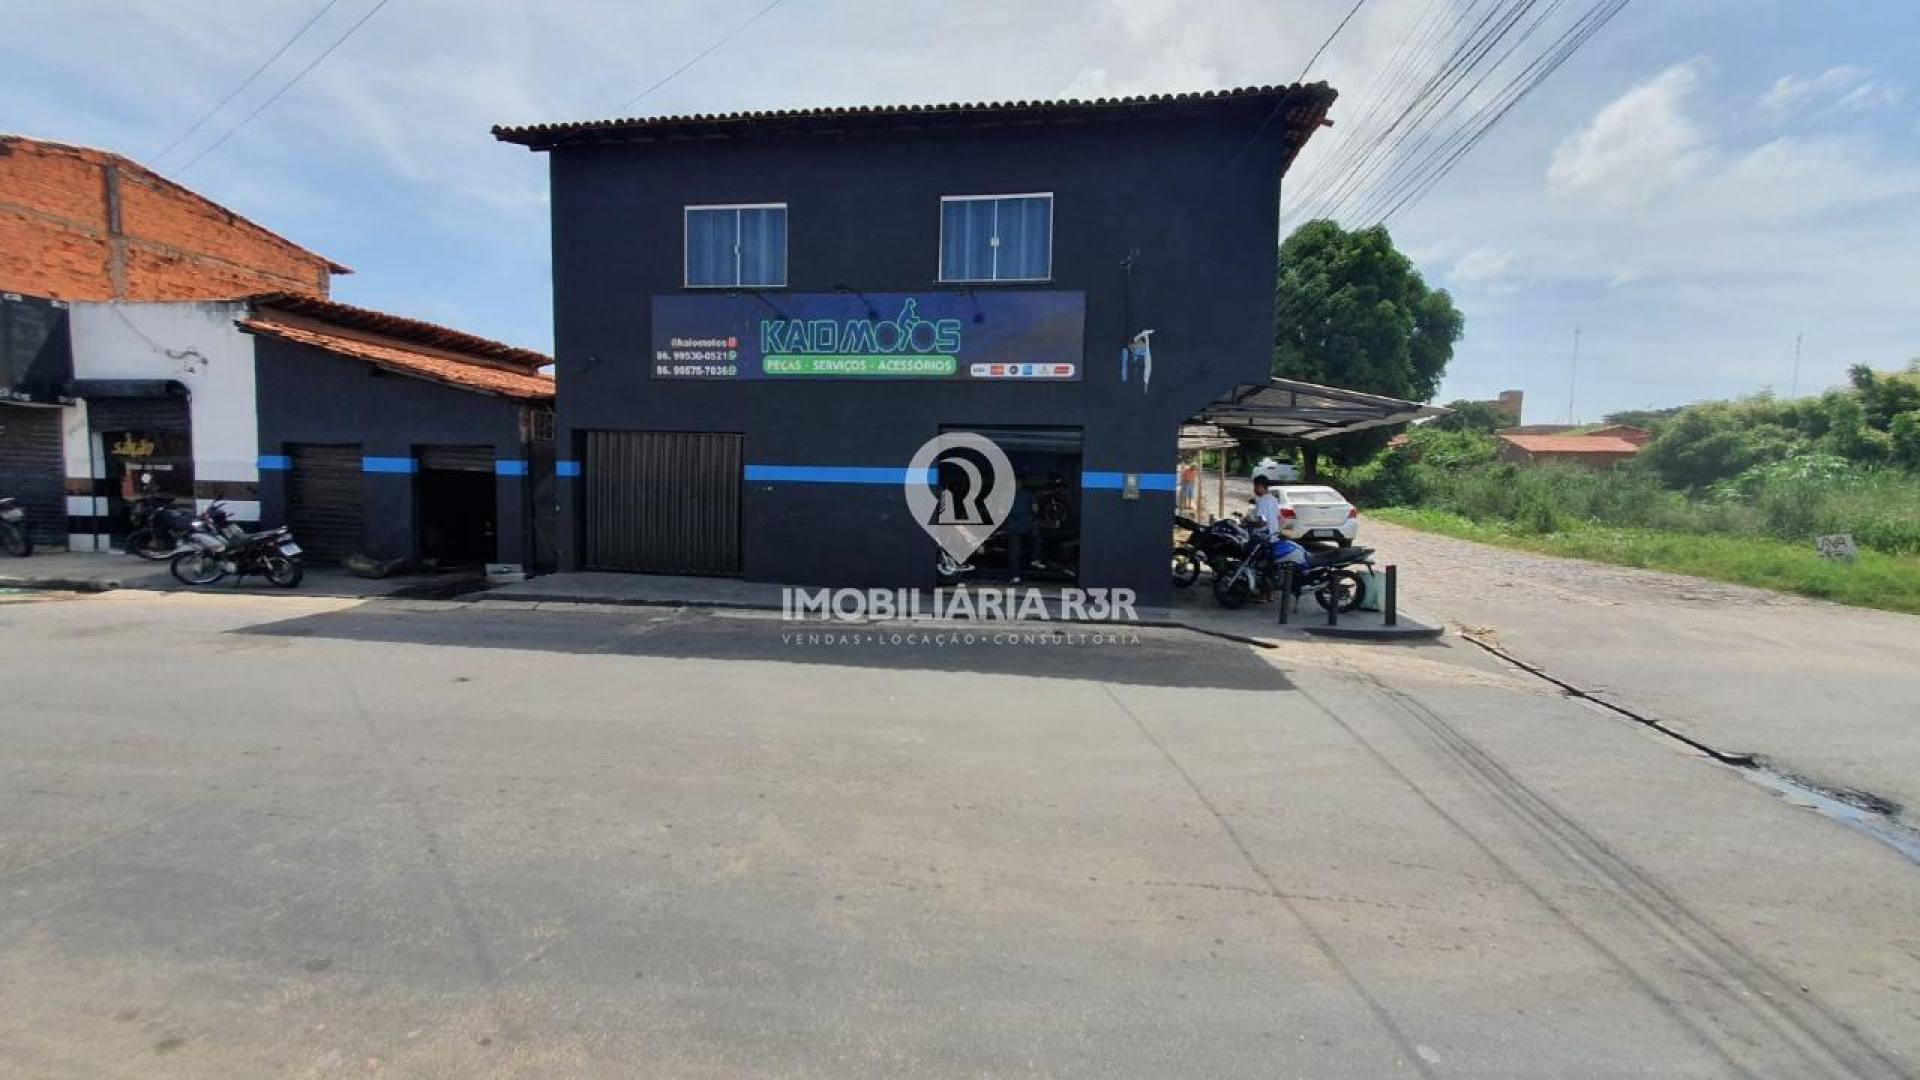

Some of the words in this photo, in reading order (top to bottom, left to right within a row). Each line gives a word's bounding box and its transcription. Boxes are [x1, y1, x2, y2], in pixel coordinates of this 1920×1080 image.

[767, 359, 800, 371] PEÇAS
[813, 359, 867, 373] SERVIÇOS
[879, 357, 952, 371] ACESSÓRIOS
